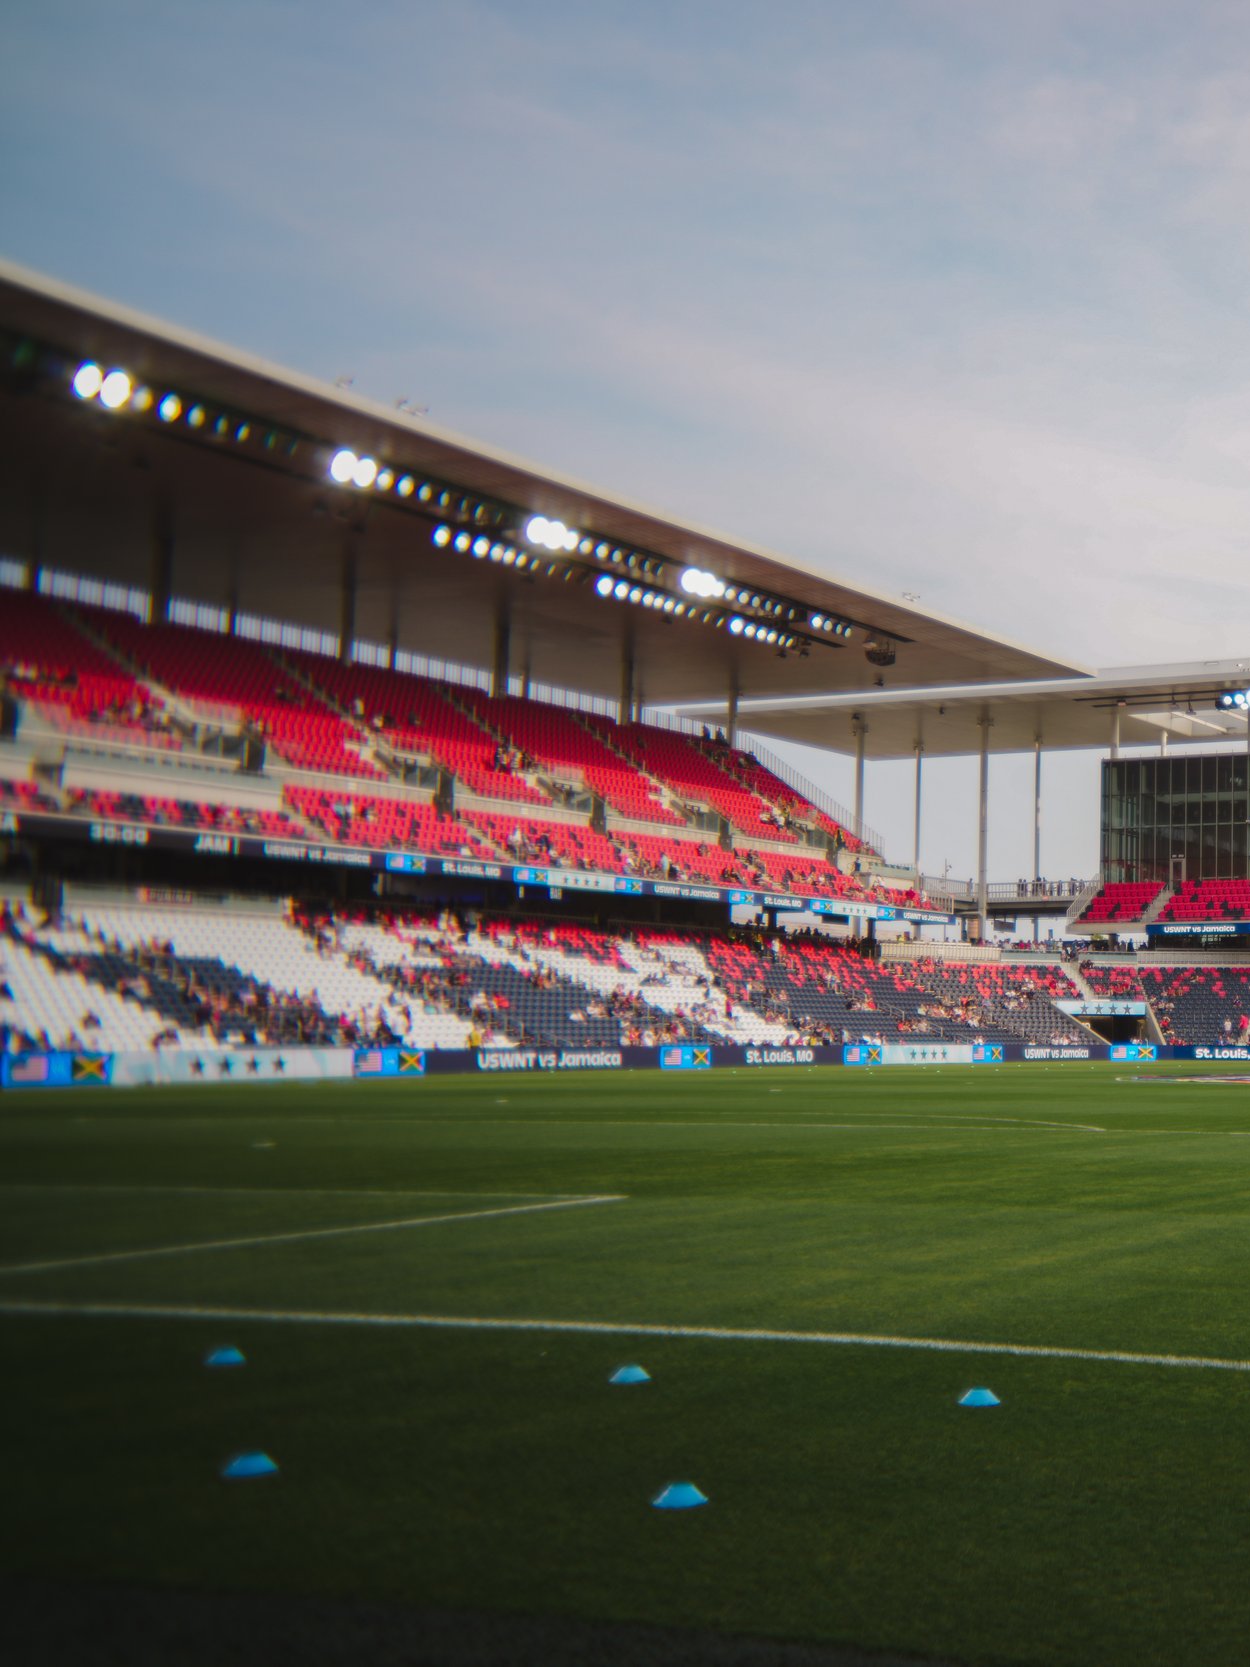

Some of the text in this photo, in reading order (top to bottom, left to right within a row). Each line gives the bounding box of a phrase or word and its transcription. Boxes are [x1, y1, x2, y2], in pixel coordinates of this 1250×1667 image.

[194, 833, 231, 853] JAM
[654, 885, 719, 899] USWNT vs Jamaica
[477, 1050, 622, 1069] USWNT vs Jamaica
[746, 1049, 813, 1064] St. Louis, MO
[1024, 1047, 1089, 1058] USWNT vs Jamaica
[1195, 1048, 1212, 1059] St.
[1215, 1048, 1250, 1060] Louis,
